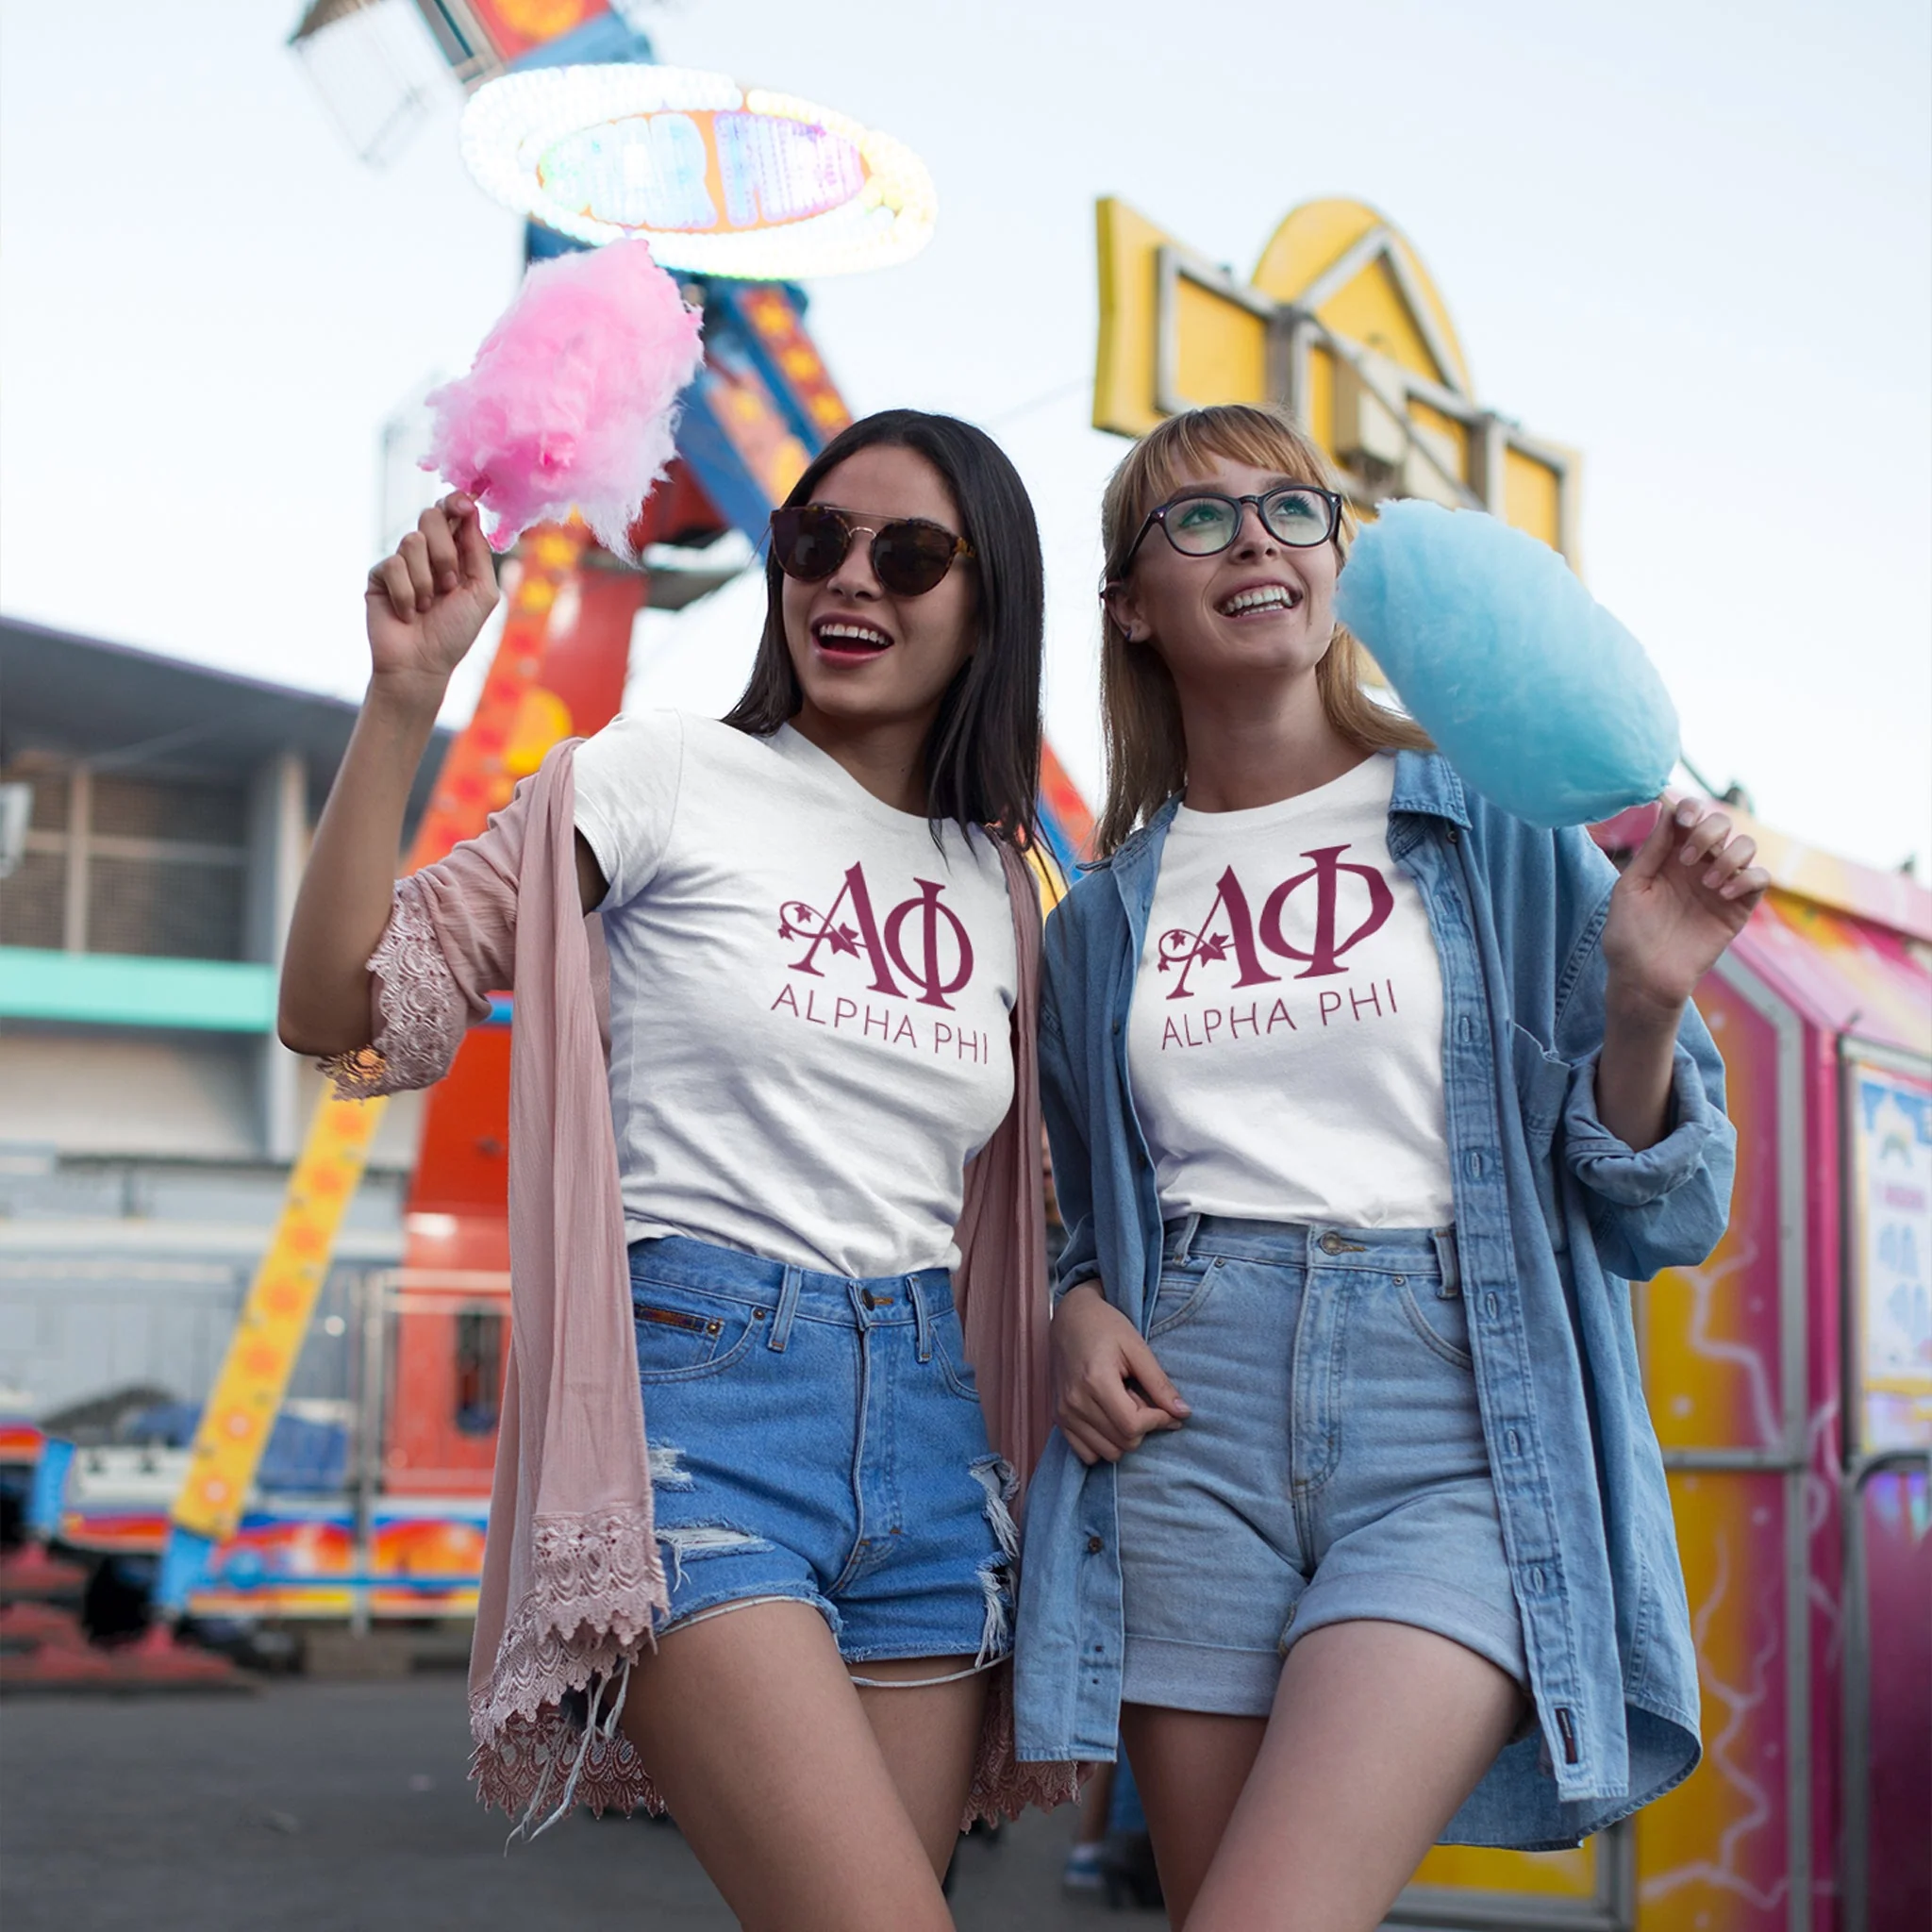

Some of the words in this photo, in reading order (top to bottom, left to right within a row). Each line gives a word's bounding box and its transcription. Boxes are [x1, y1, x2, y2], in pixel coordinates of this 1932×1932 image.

[771, 984, 918, 1049] ALPHA
[933, 1022, 989, 1066] PHI
[1159, 997, 1297, 1051] ALPHA
[1319, 978, 1398, 1027] PHI
